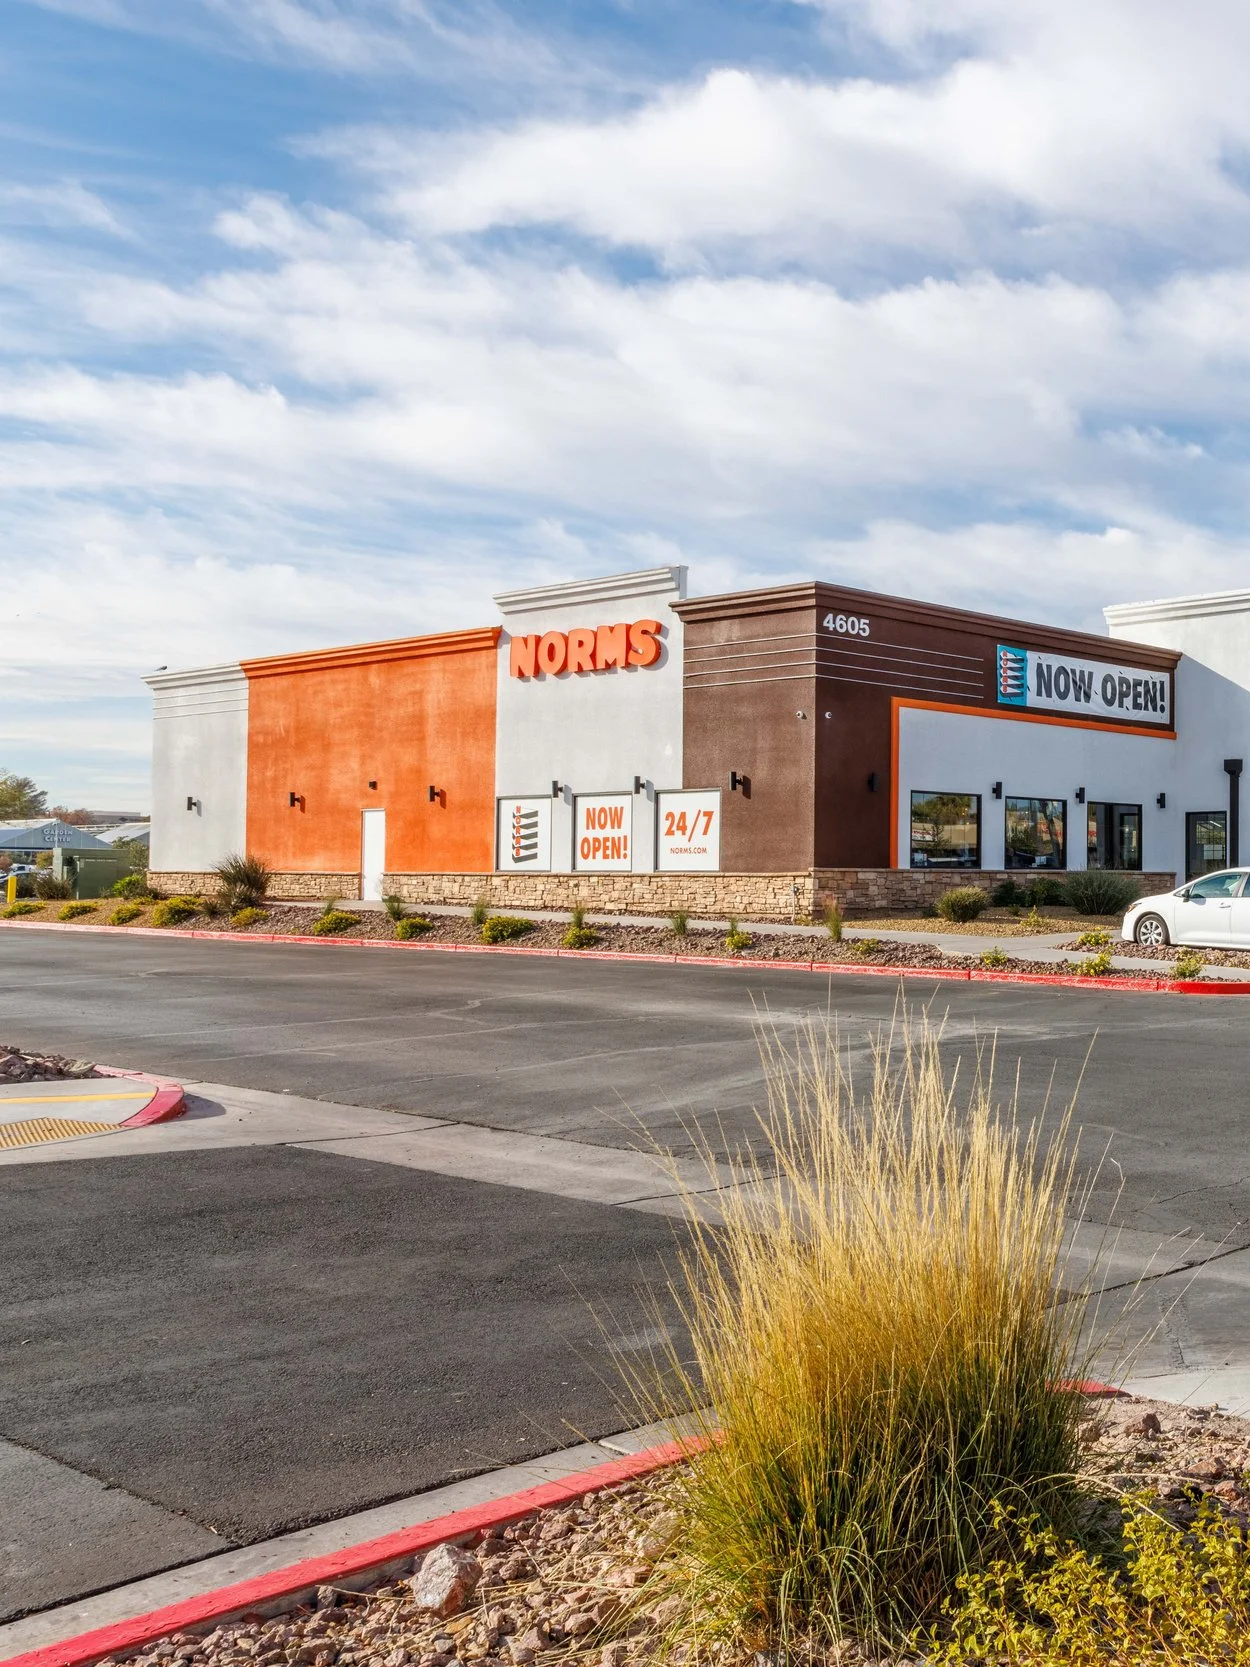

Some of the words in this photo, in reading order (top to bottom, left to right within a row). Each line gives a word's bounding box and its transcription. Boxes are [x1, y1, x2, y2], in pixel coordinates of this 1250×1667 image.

[823, 613, 870, 637] 4605
[510, 619, 662, 678] NORMS
[1036, 662, 1094, 703] NOW
[1101, 673, 1166, 713] OPEN!
[586, 806, 624, 830] NOW
[664, 809, 714, 842] 24/7
[580, 835, 628, 860] OPEN!
